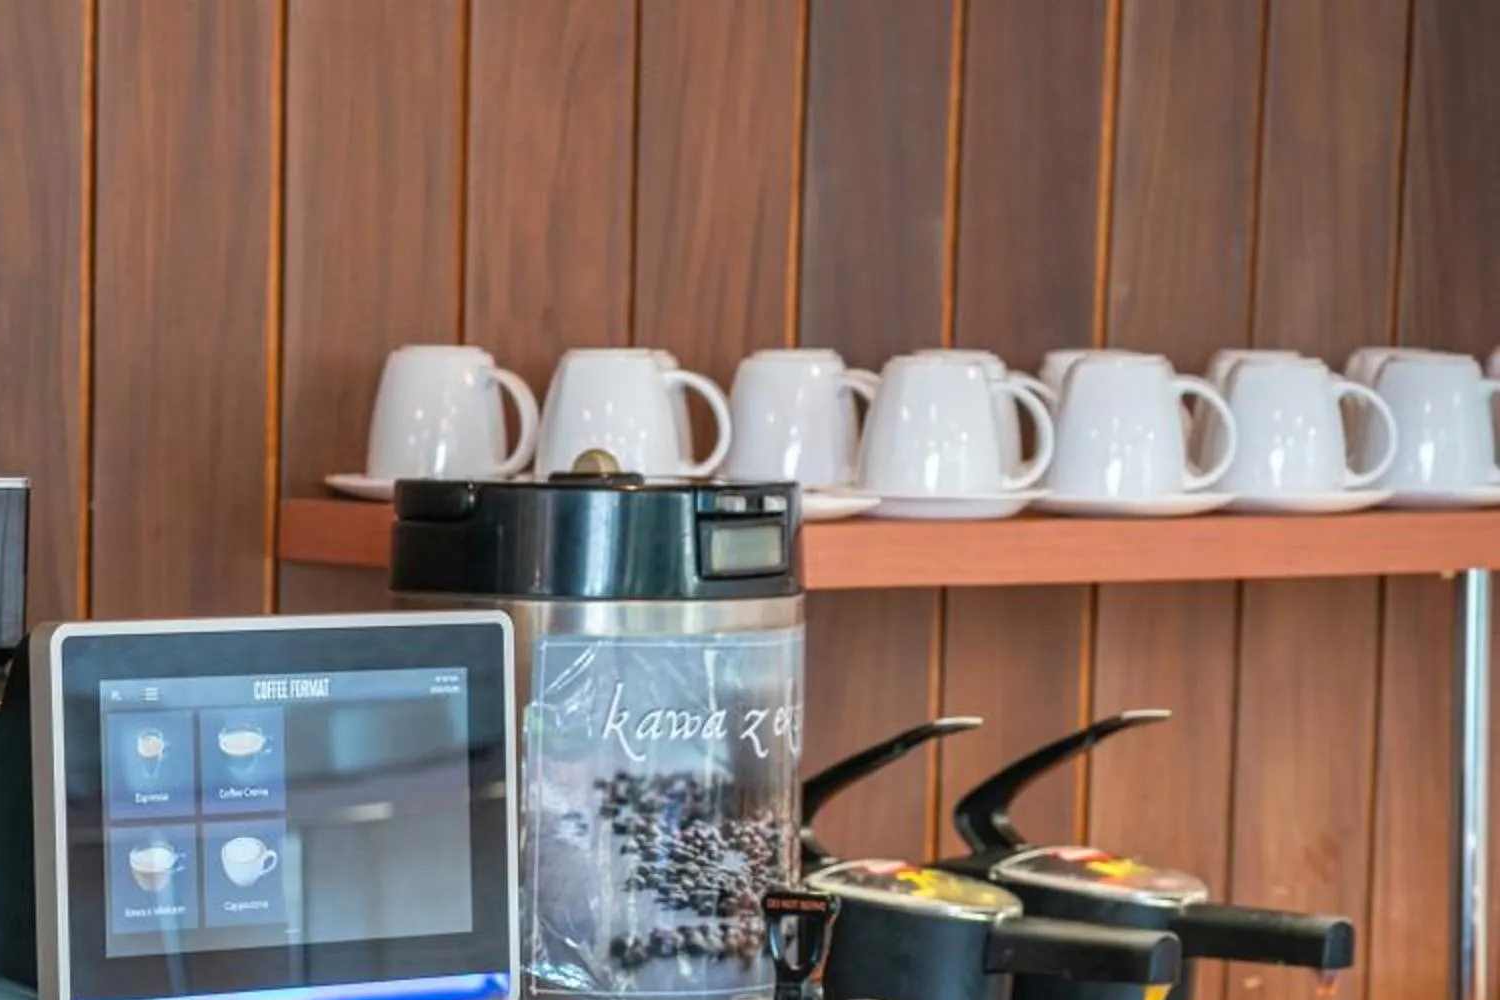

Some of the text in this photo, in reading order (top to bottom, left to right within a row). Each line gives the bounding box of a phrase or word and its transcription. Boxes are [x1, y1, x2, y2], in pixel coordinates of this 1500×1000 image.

[253, 678, 330, 701] COFFEE FORMAT
[602, 682, 728, 762] kawa
